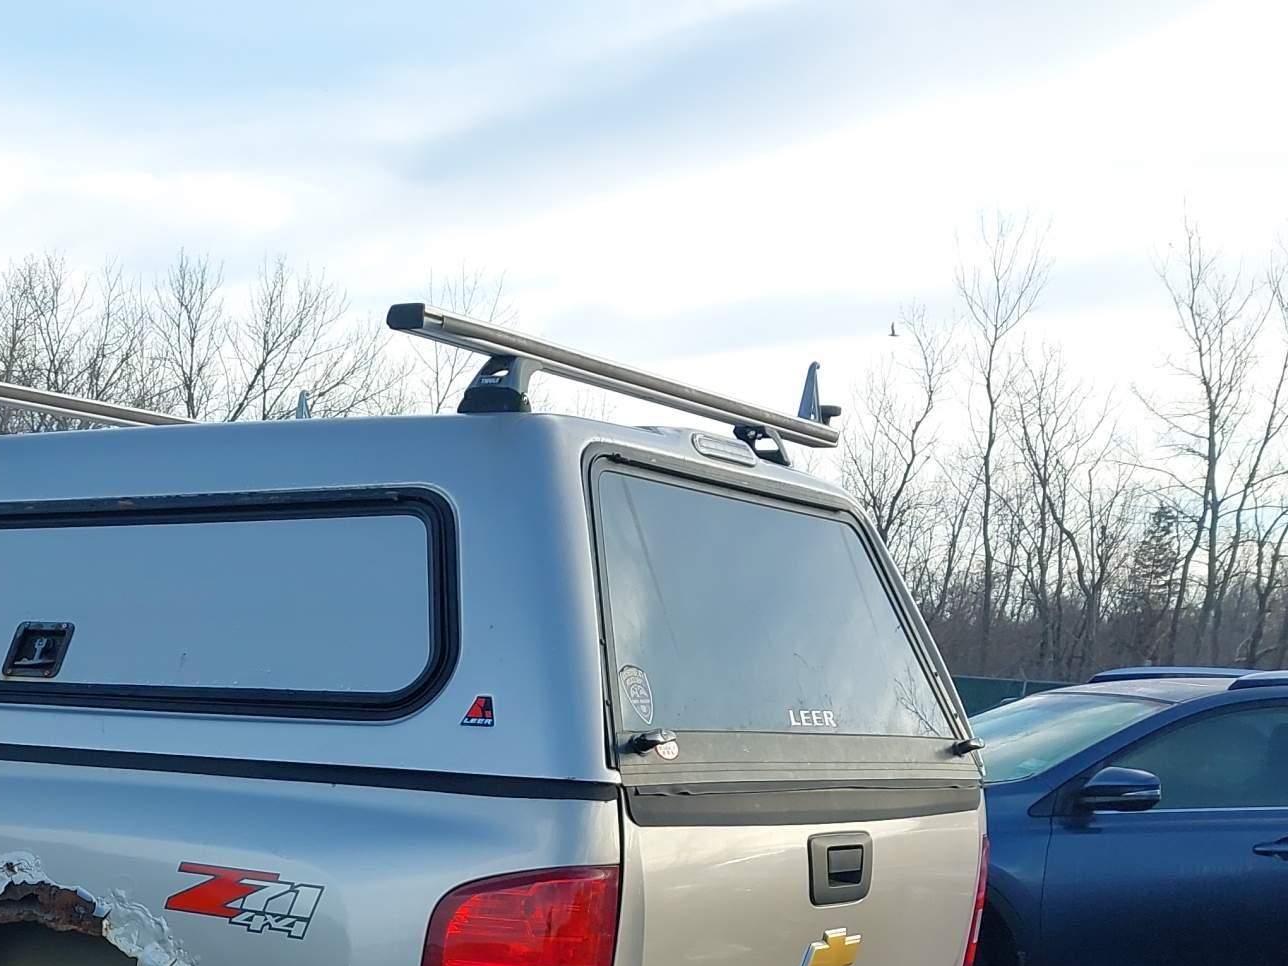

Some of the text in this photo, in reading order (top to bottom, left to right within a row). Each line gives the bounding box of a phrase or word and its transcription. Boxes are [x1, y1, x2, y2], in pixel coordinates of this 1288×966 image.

[463, 717, 493, 725] LEER
[788, 709, 837, 727] LEER
[164, 861, 325, 919] Z71
